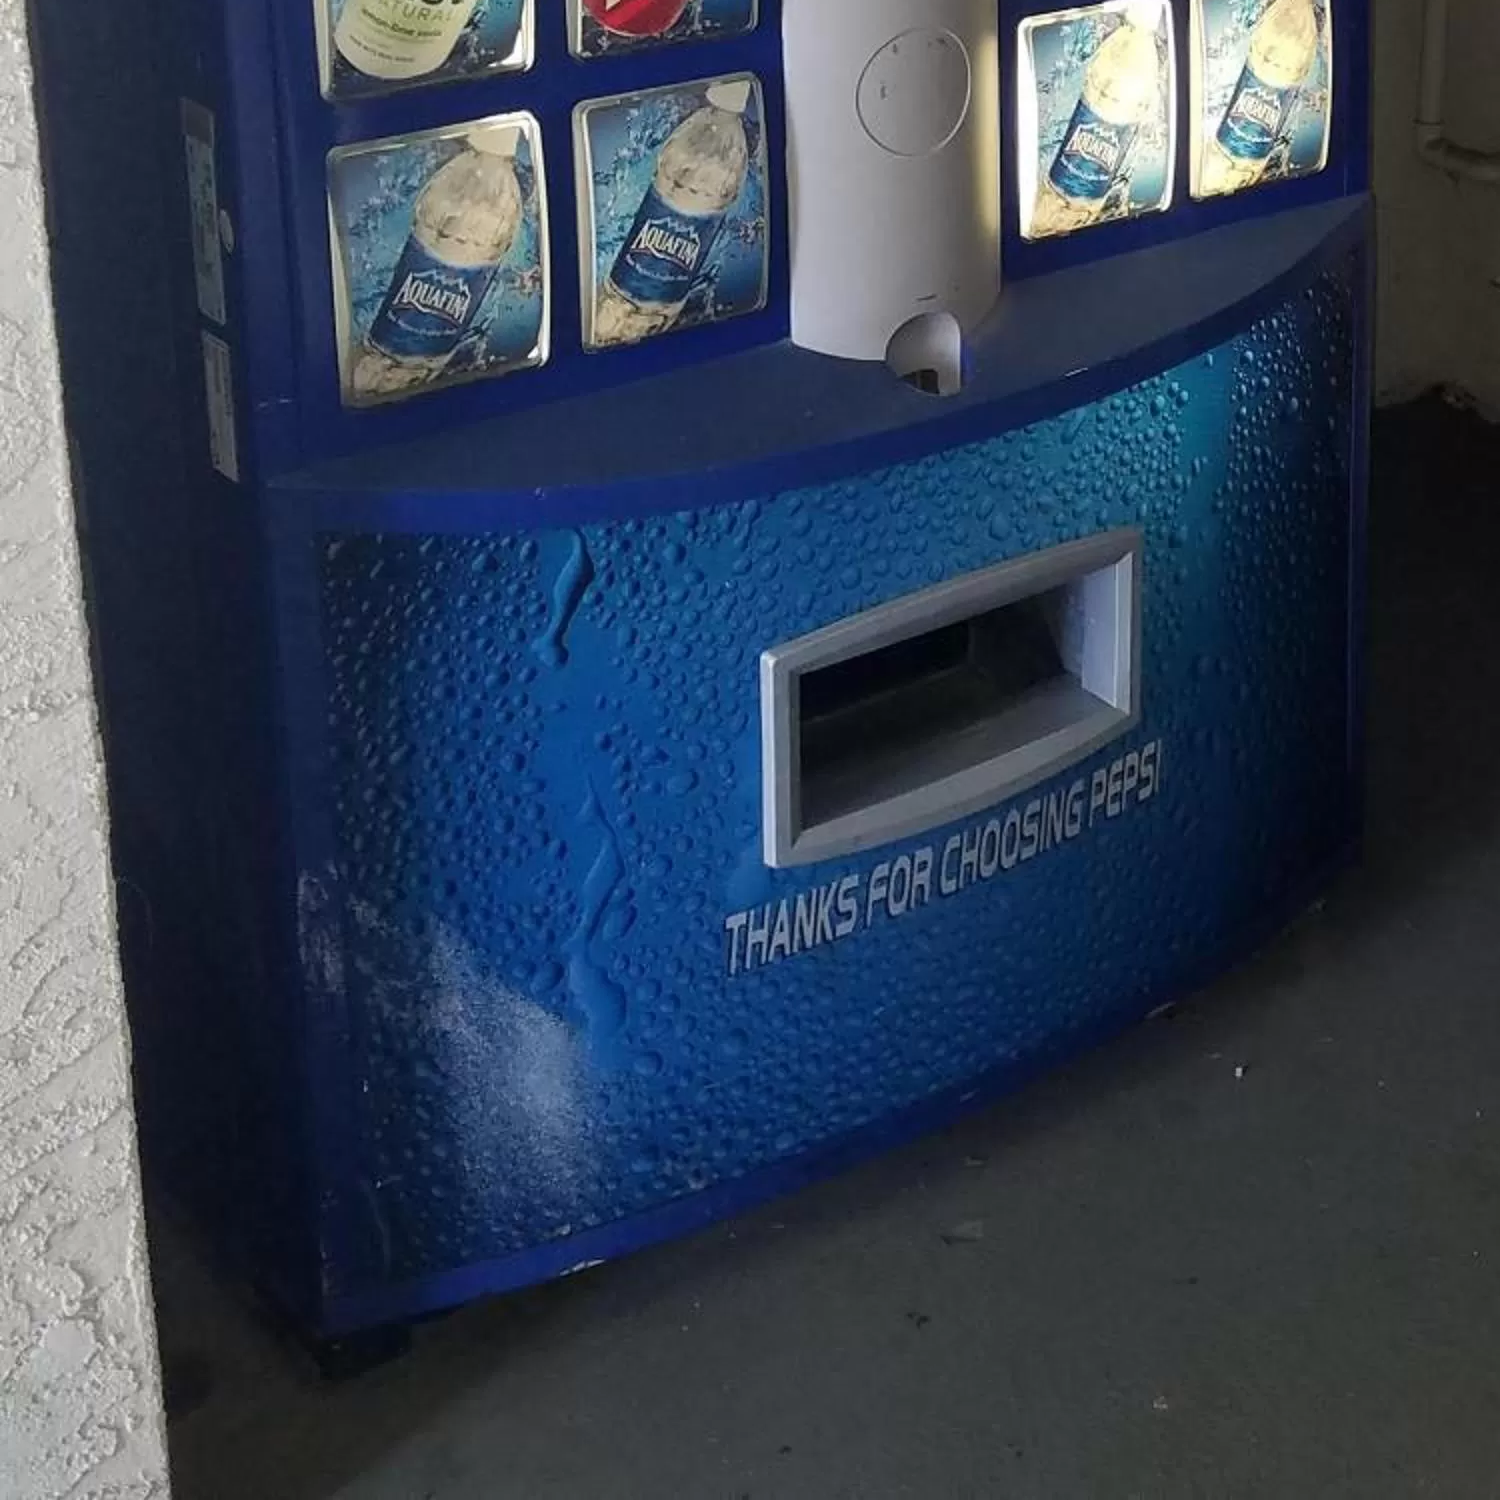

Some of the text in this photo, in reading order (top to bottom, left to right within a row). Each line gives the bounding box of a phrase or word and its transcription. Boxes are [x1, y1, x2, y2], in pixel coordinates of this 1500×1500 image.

[630, 218, 700, 271] AQUAFINA
[392, 272, 469, 324] AQUAFINA
[724, 738, 1163, 977] THANKS FOR CHOOSING PEPSI
